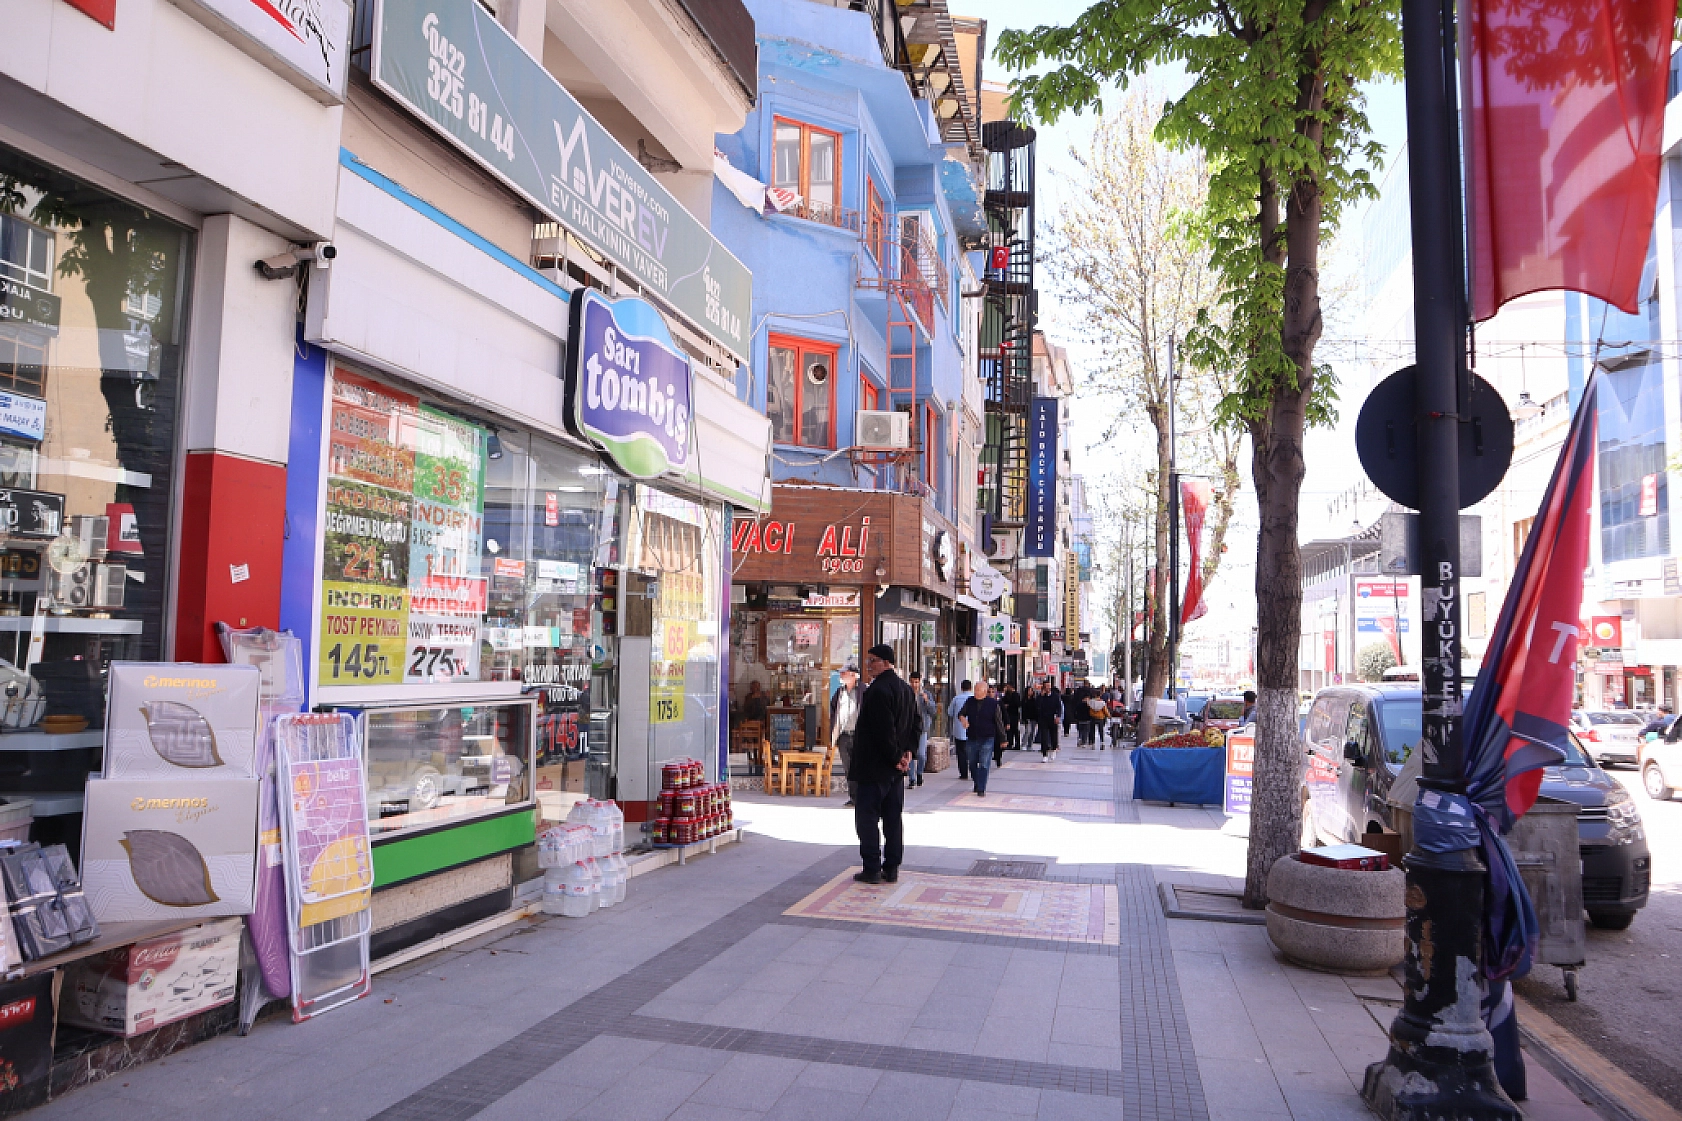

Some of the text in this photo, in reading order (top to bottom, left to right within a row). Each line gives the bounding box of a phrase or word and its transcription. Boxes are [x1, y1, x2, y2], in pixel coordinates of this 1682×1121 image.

[429, 26, 465, 81] 0422
[428, 57, 515, 162] 325 81 44
[552, 183, 570, 212] EV
[572, 201, 630, 262] HALKININ
[604, 326, 640, 374] Sarı
[586, 353, 688, 460] tombiş
[815, 516, 871, 557] ALİ
[327, 615, 357, 635] TOST
[147, 797, 208, 809] merinos
